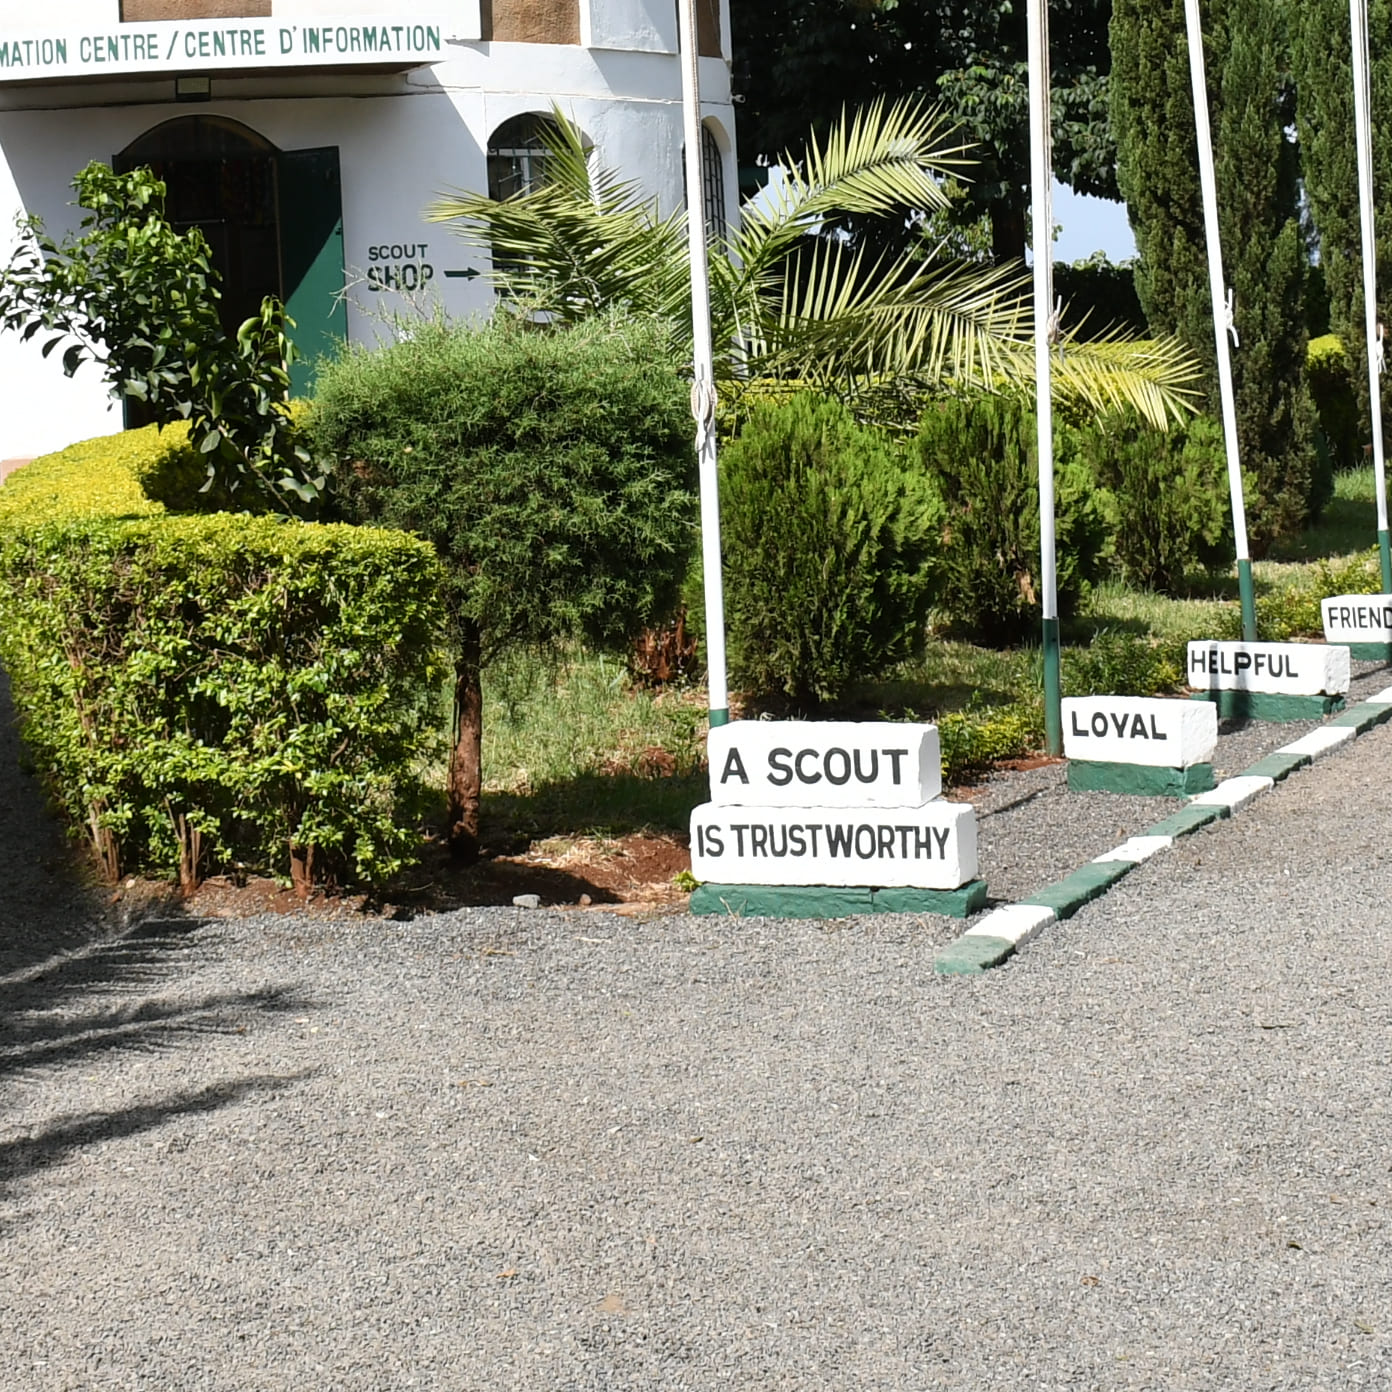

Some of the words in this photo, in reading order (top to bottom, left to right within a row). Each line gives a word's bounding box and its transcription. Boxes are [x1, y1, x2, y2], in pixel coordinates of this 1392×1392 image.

[79, 33, 159, 63] CENTRE
[184, 28, 266, 57] CENTRE
[368, 244, 428, 261] SCOUT
[366, 263, 434, 292] SHOP
[1191, 649, 1299, 678] HELPFUL
[1071, 710, 1168, 741] LOYAL
[720, 747, 750, 785] A
[766, 747, 909, 787] SCOUT
[696, 824, 725, 858] IS
[730, 823, 950, 860] TRUSTWORTHY
